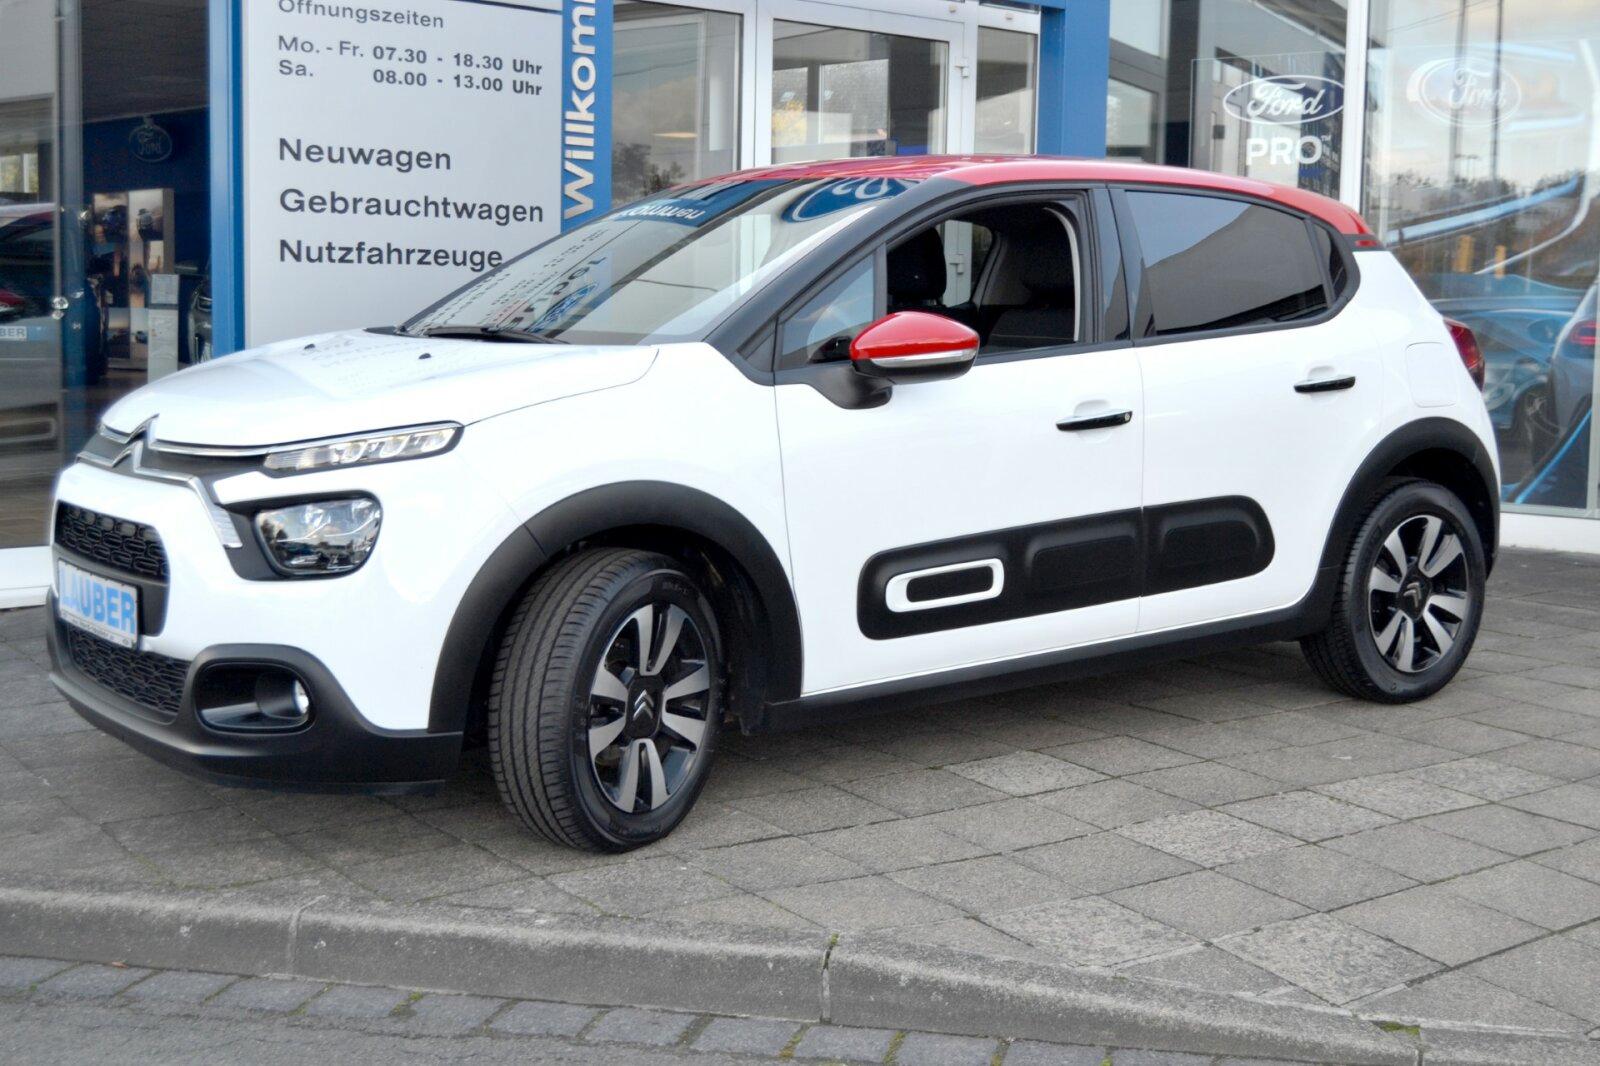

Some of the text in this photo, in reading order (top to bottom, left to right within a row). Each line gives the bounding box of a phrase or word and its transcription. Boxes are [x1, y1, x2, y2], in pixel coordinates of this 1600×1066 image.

[279, 35, 320, 53] Mo.
[339, 40, 364, 57] Fr.
[373, 46, 427, 64] 07.30
[453, 53, 503, 71] 18.30
[512, 58, 542, 75] Uhr
[279, 59, 314, 77] Sa.
[373, 69, 427, 87] 08.00
[453, 74, 503, 92] 13.00
[512, 79, 542, 96] Uhr
[564, 0, 597, 220] Willkom
[1247, 82, 1325, 117] Ford
[279, 138, 451, 173] Neuwagen
[279, 188, 543, 226] Gebrauchtwagen
[279, 239, 503, 272] Nutzfahrzeuge
